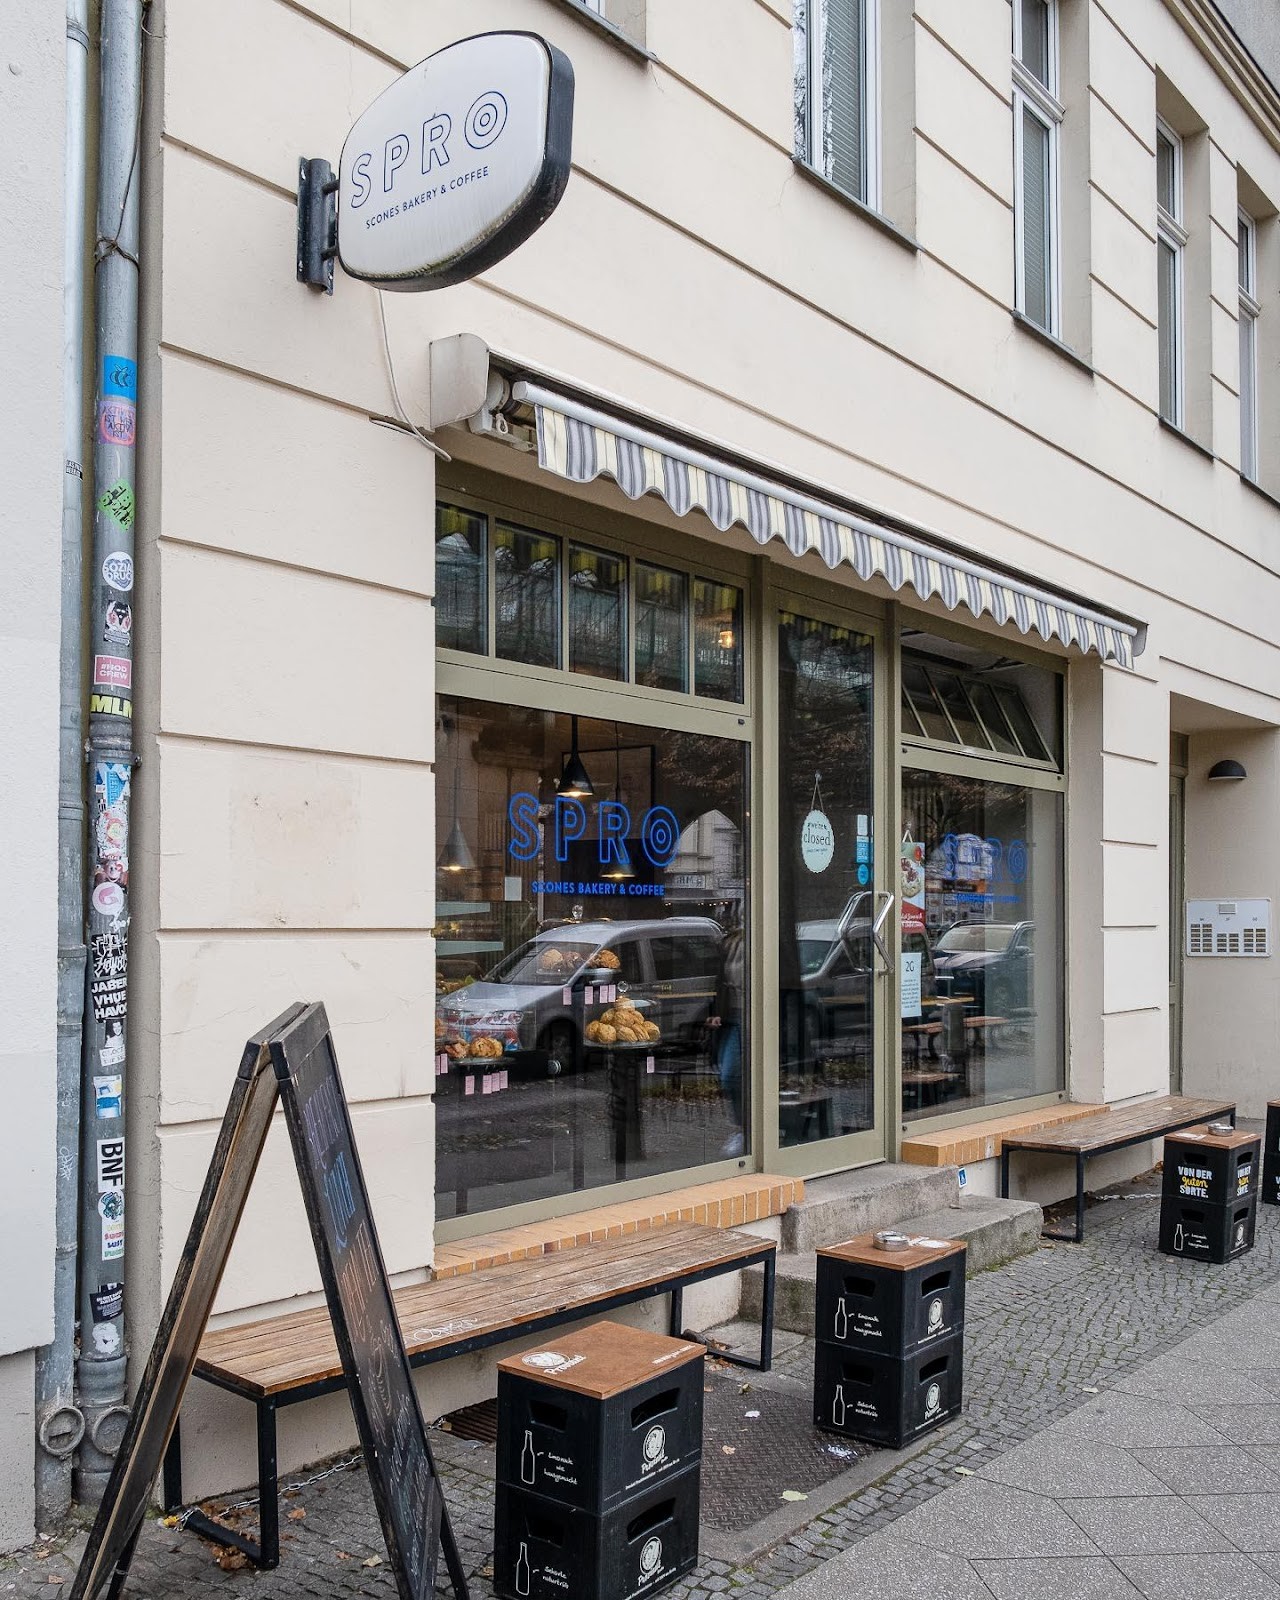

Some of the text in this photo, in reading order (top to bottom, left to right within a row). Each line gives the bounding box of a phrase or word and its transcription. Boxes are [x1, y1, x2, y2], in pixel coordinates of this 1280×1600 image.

[350, 90, 508, 209] SPRO
[366, 165, 490, 230] SCONES BAKERY & COFFEE
[509, 792, 681, 867] SPRO
[803, 828, 831, 846] closed
[532, 881, 665, 896] SCONES BAKERY & COFFEE
[905, 960, 915, 972] 2G
[101, 1141, 124, 1187] BNF
[1178, 1165, 1213, 1181] VON DER
[1180, 1185, 1209, 1199] SORTE.
